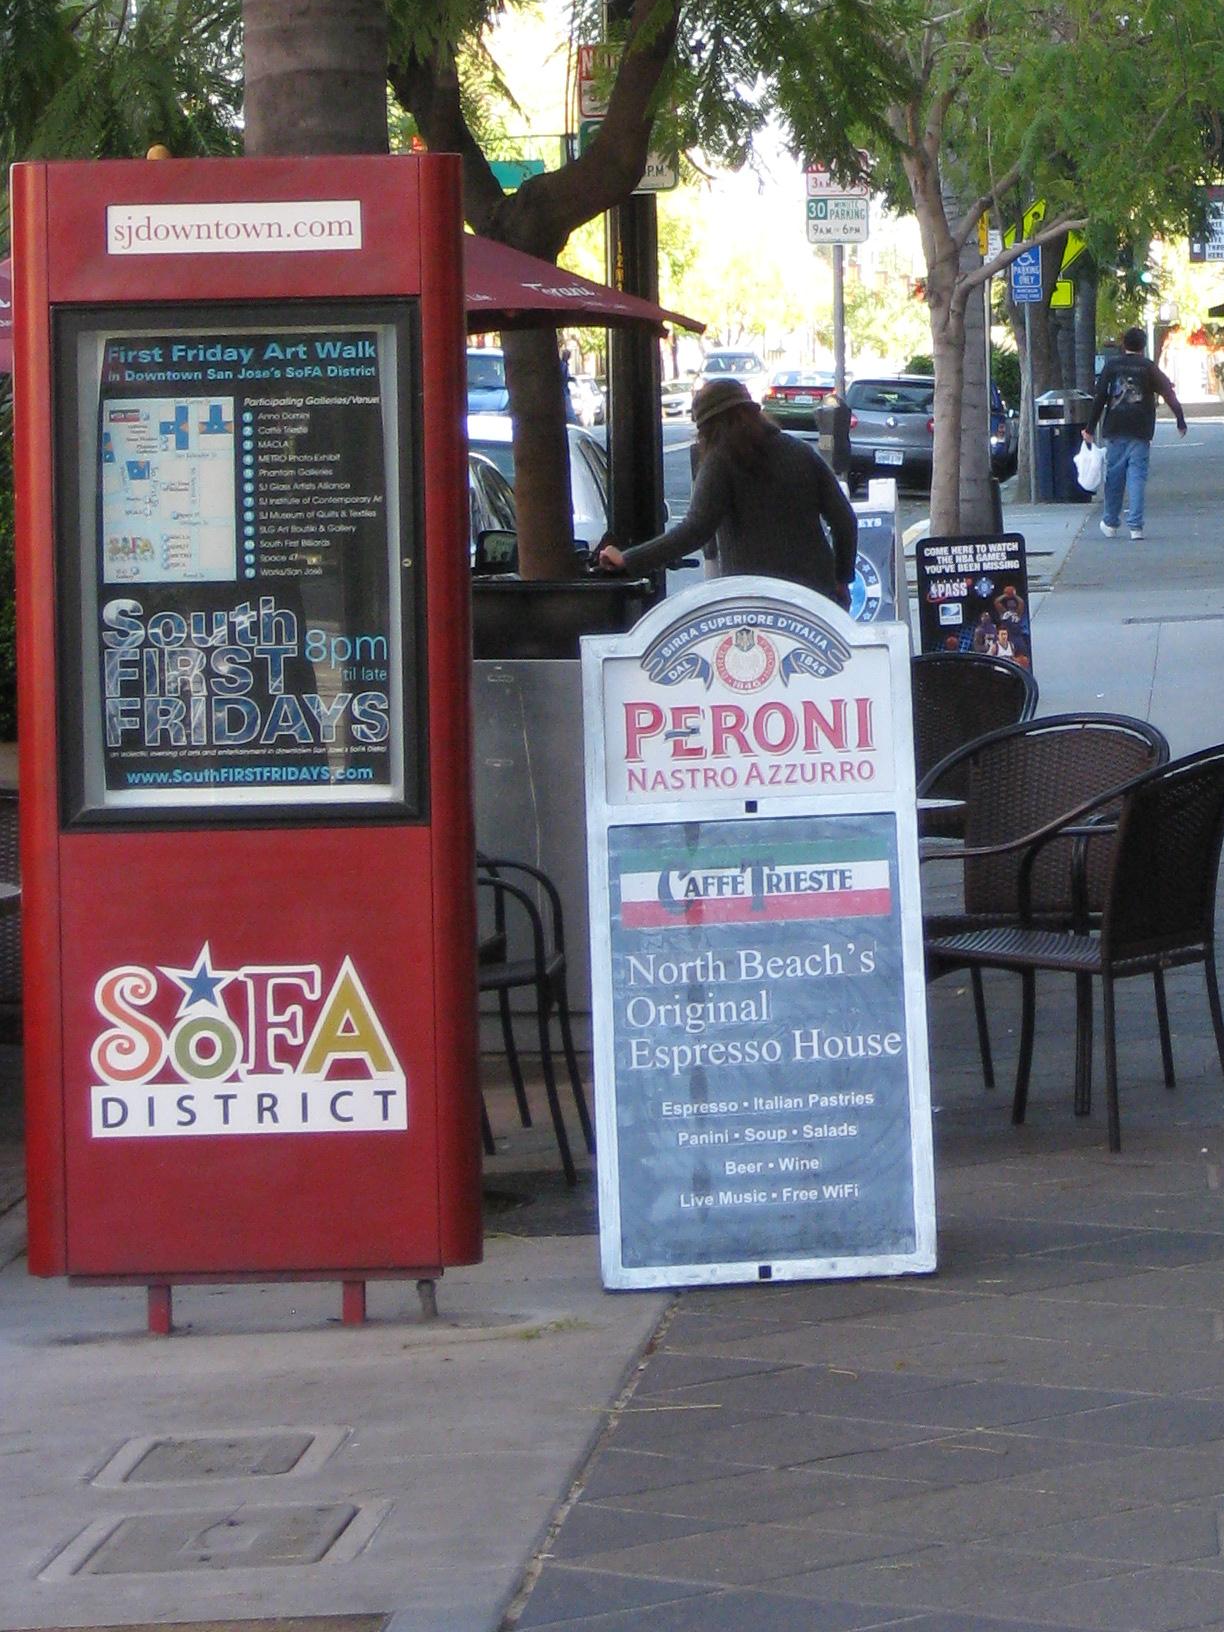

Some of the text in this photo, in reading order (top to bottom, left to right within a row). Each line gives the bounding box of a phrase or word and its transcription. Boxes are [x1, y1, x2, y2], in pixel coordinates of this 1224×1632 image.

[808, 202, 826, 218] 30
[830, 209, 865, 220] PARKING
[113, 216, 355, 250] sjdowntown.com
[108, 341, 376, 365] First Friday Art Walk
[109, 373, 119, 381] in
[125, 369, 202, 381] Downtown
[207, 368, 233, 380] San
[286, 366, 322, 378] SoFA
[327, 366, 376, 377] District
[244, 397, 303, 407] Participating
[258, 454, 287, 463] METRO
[318, 482, 350, 490] Alliance
[312, 495, 371, 505] Contemporary
[270, 511, 304, 519] Museum
[924, 541, 1019, 557] COME HERE TO WATCH
[937, 552, 1007, 565] THE NBA GAMES
[924, 560, 1020, 574] YOU'VE BEEN MISSING
[938, 582, 968, 598] PASS
[102, 596, 298, 649] South
[662, 626, 699, 658] BIRRA
[700, 614, 774, 633] SUPERIORE
[778, 618, 829, 651] D'ITALIA
[305, 629, 388, 668] 8pm
[104, 646, 298, 698] FIRST
[361, 667, 387, 682] late
[668, 660, 692, 681] DAL
[799, 653, 828, 675] 1846
[105, 692, 390, 747] FRIDAYS
[622, 697, 878, 763] PERONI
[127, 765, 374, 785] www.SouthFIRSTFRIDAYS.com
[626, 760, 876, 793] NASTRO AZZURRO
[741, 858, 853, 913] TRIESTE
[626, 942, 876, 987] North Beach's
[626, 990, 769, 1033] Original
[629, 1028, 903, 1076] Espresso House
[102, 1089, 397, 1129] DISTRICT
[662, 1091, 875, 1118] Espresso Italian Pastries
[678, 1122, 858, 1146] Panini Soup Salads
[725, 1155, 820, 1175] Beer Wine
[680, 1183, 860, 1208] Live Music Free WiFi
